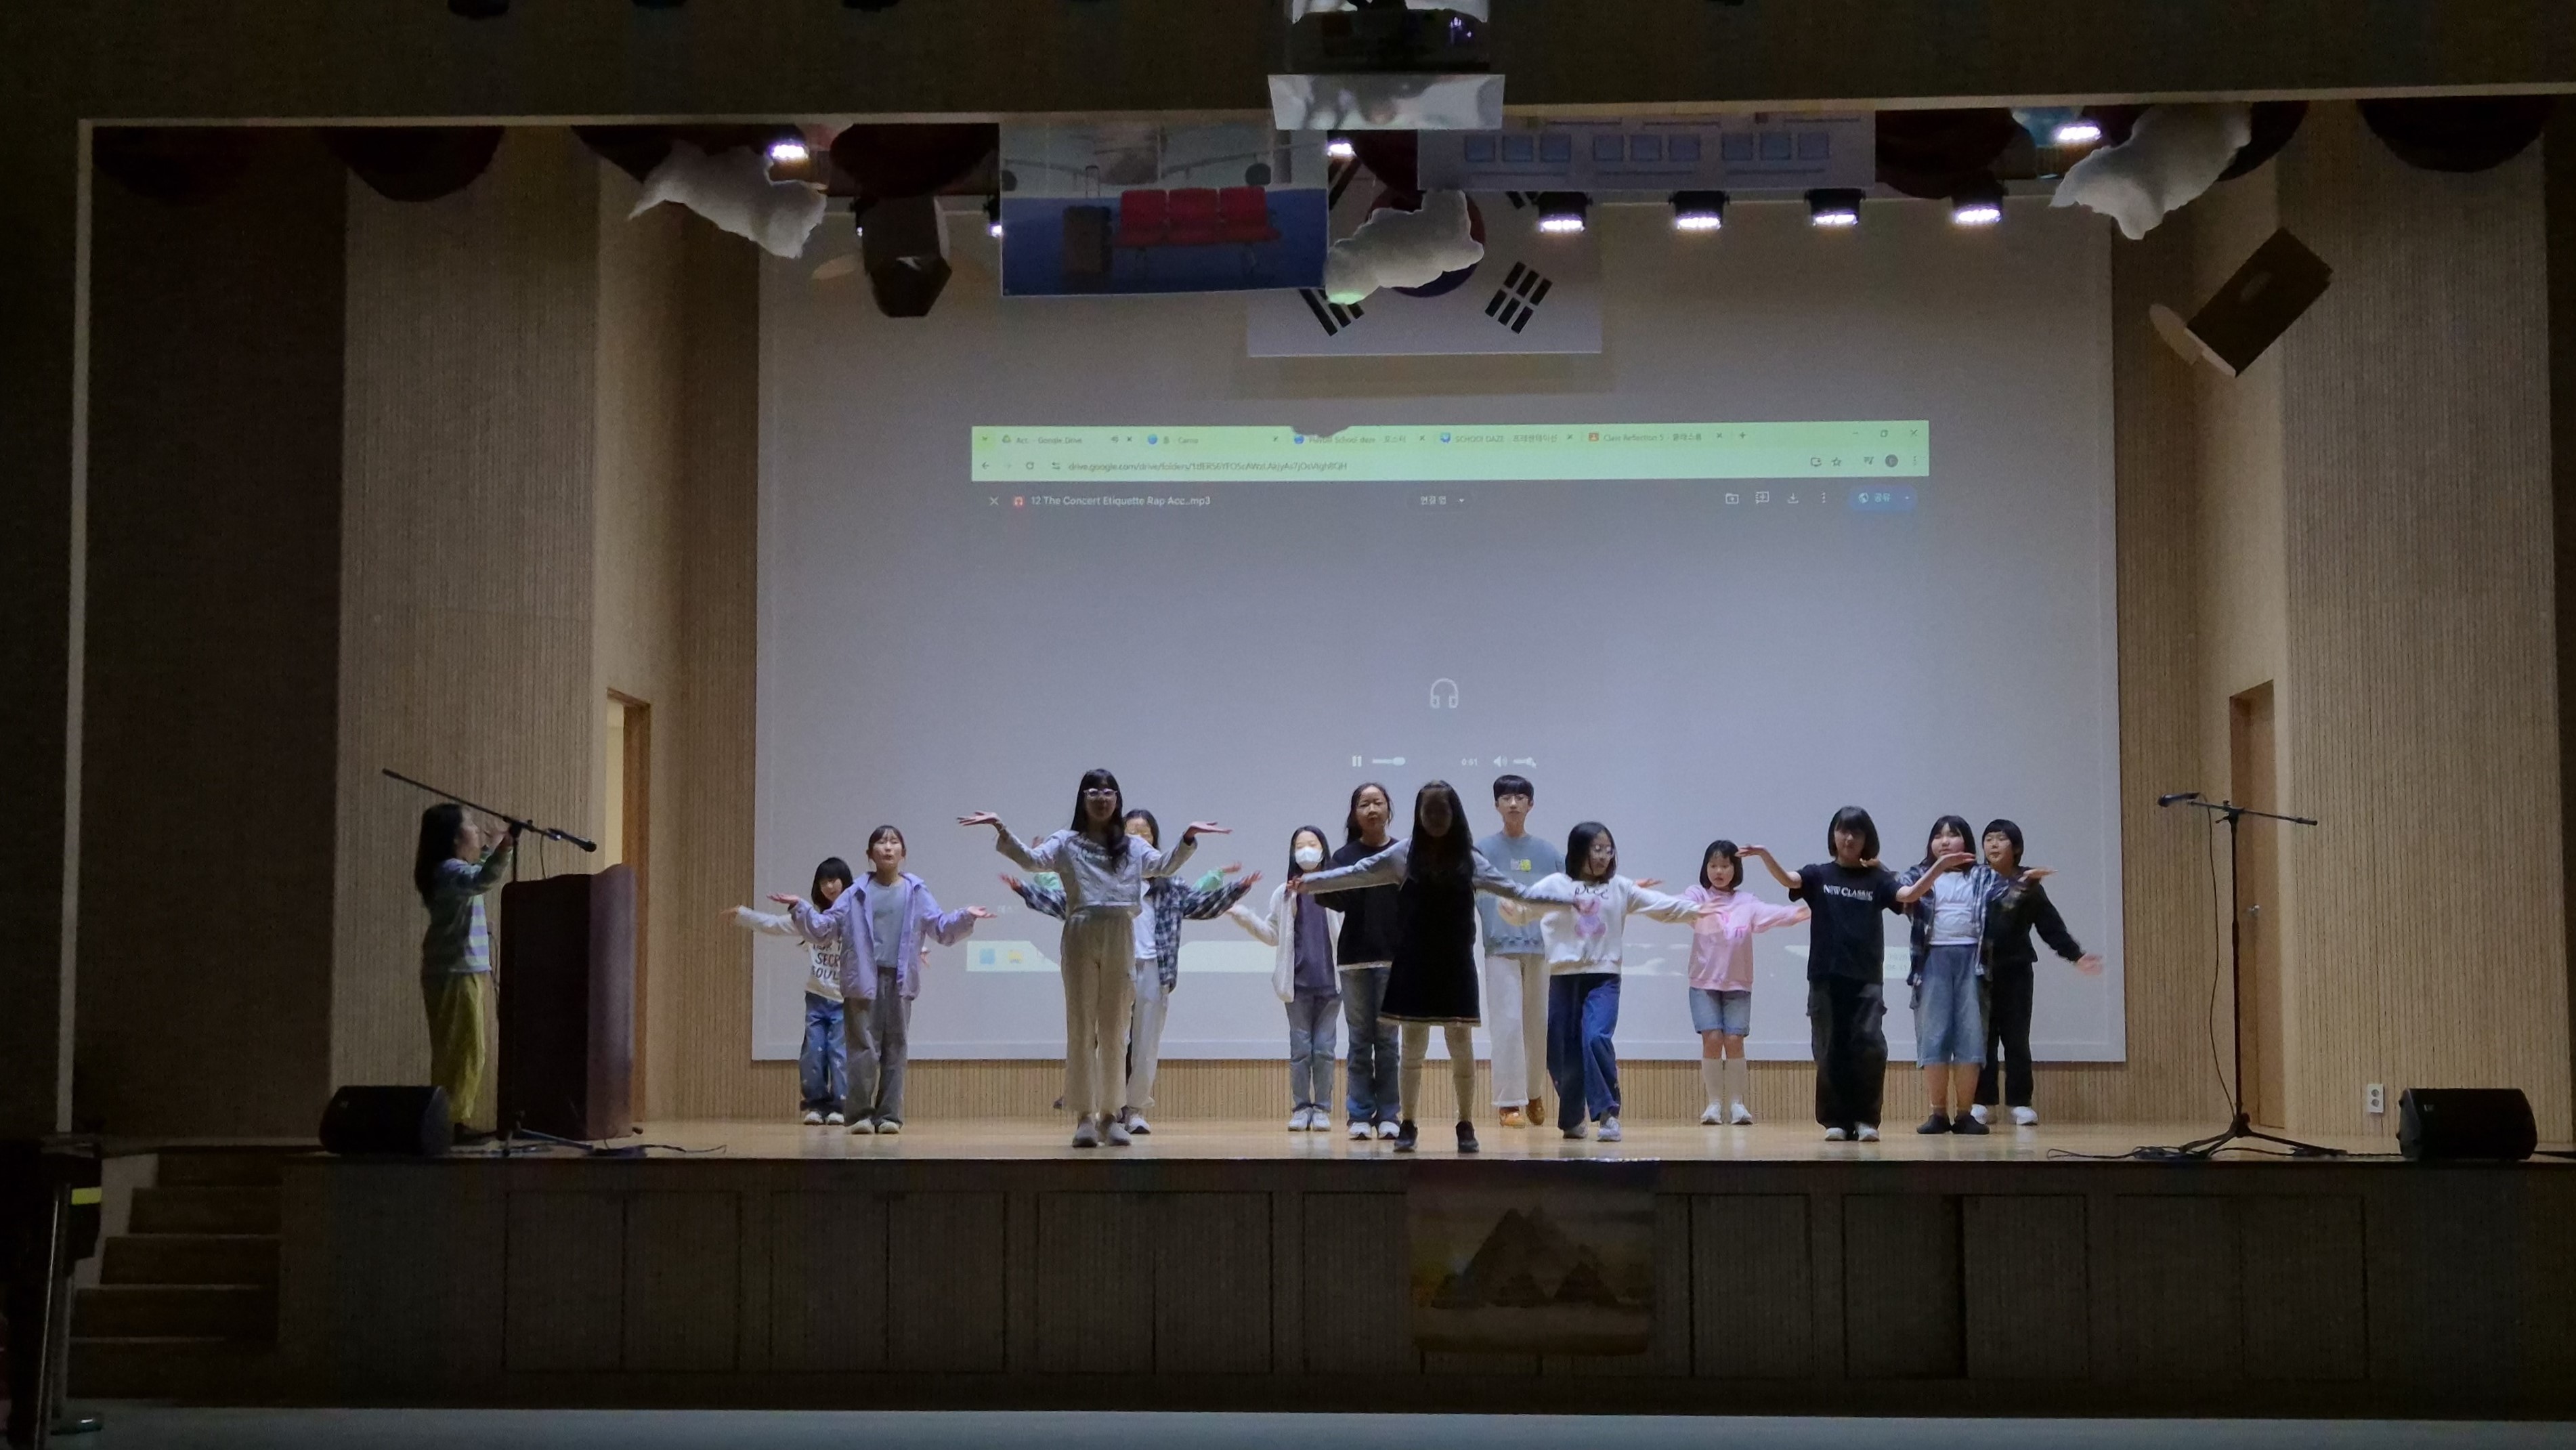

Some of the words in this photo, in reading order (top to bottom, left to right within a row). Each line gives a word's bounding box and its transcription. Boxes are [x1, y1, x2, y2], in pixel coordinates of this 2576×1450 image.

[1031, 496, 1041, 505] 12
[1044, 496, 1060, 505] The
[1062, 496, 1100, 505] Concert
[1102, 495, 1144, 507] Etiquette
[1146, 496, 1165, 507] Rap
[1874, 492, 1891, 503] 공유
